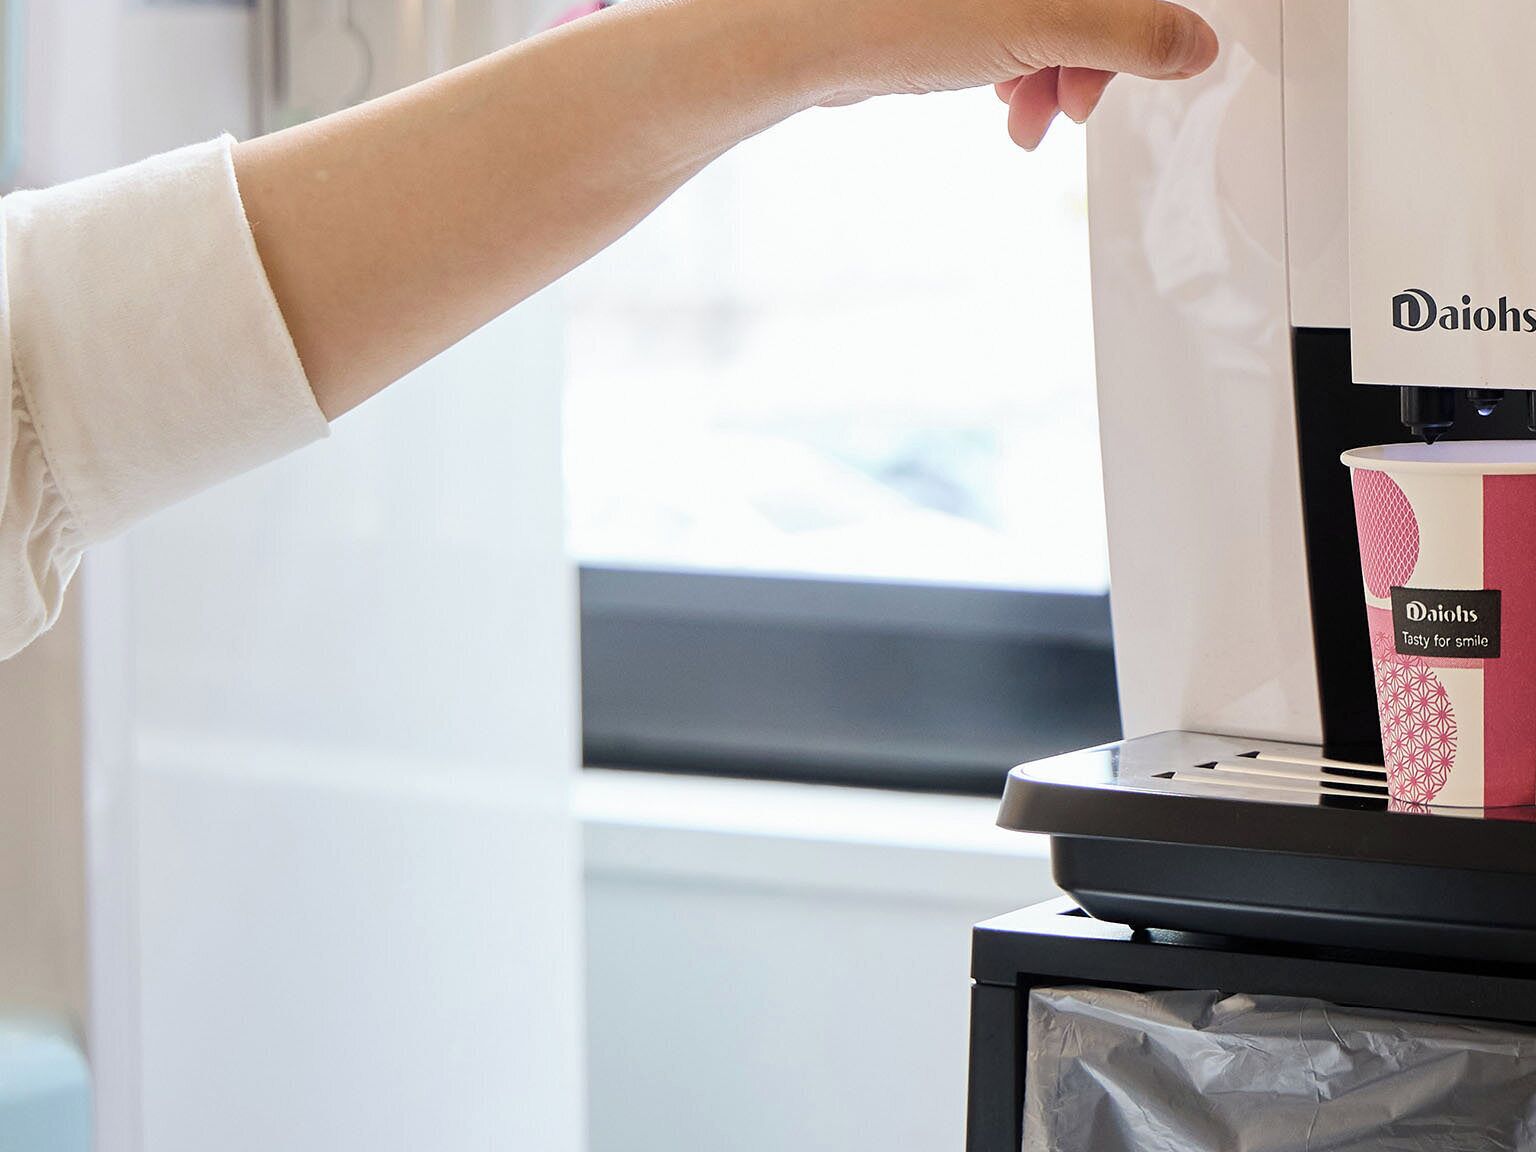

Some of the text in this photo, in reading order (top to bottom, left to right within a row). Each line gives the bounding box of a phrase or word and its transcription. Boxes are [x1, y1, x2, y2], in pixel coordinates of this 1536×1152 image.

[1406, 600, 1478, 623] Daiohs
[1402, 631, 1489, 649] Tasty for smile
